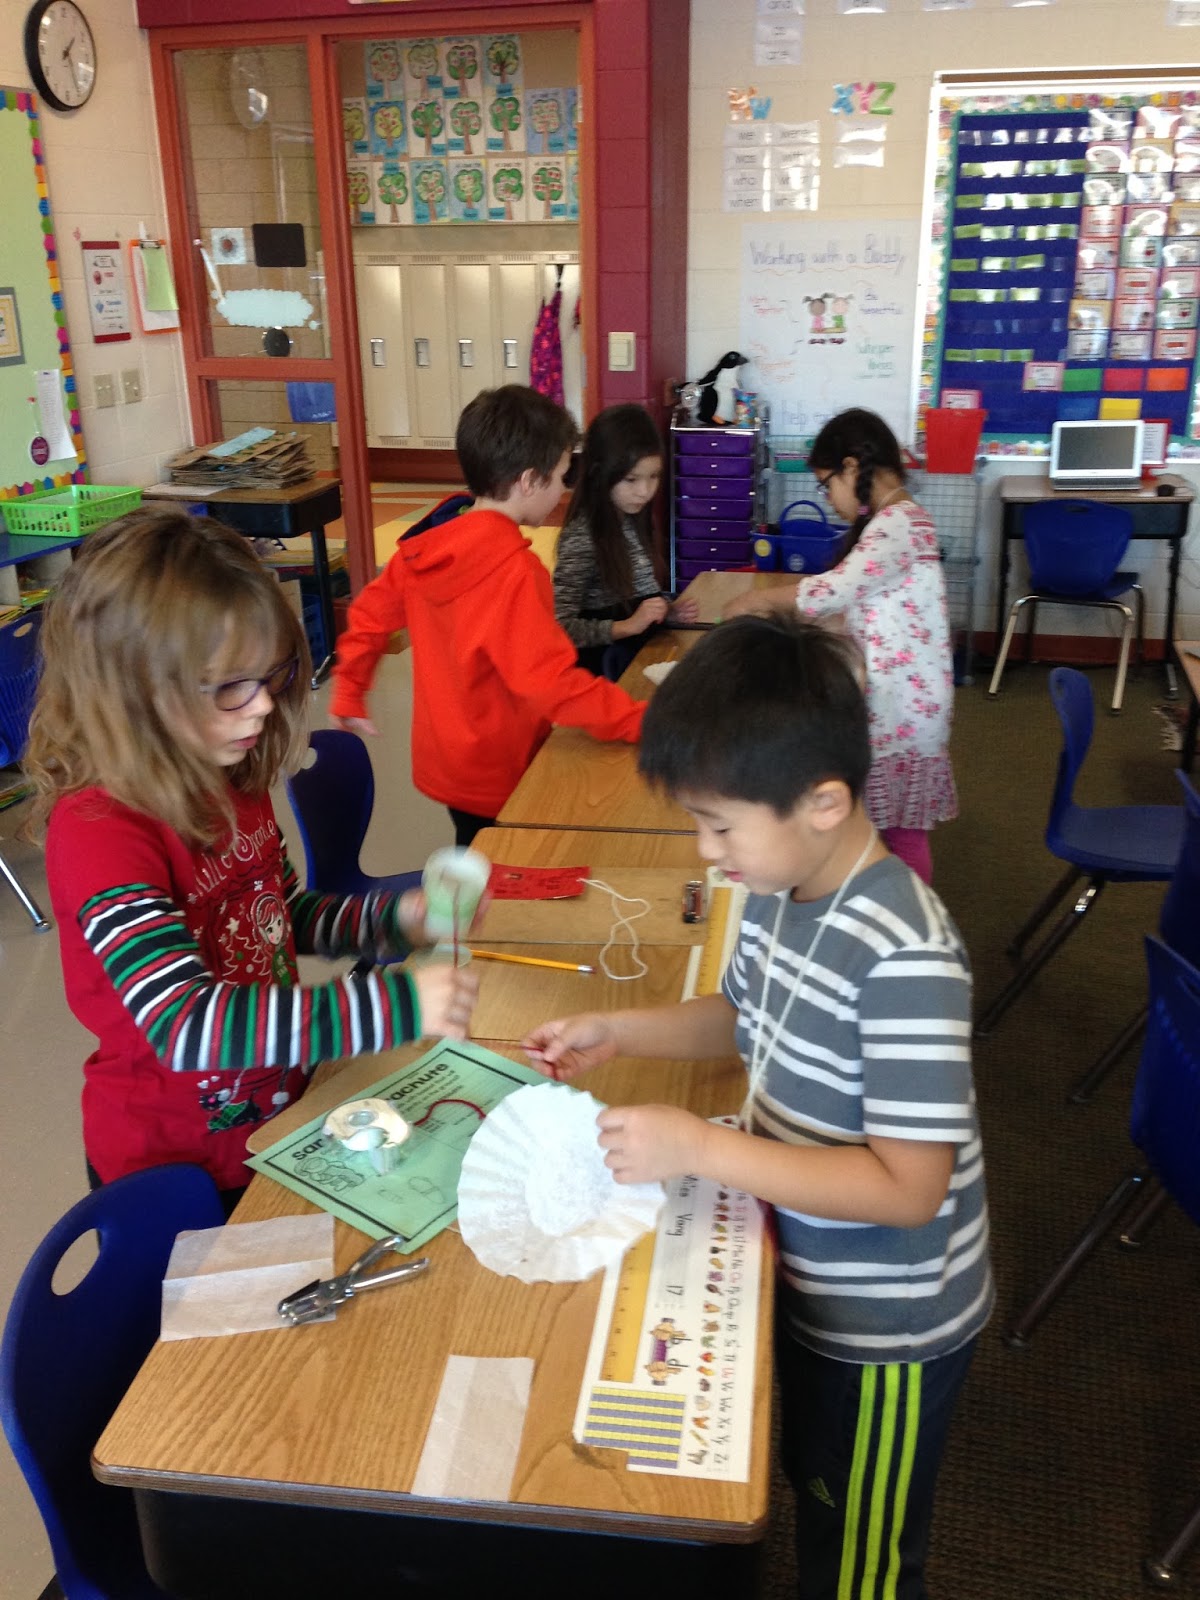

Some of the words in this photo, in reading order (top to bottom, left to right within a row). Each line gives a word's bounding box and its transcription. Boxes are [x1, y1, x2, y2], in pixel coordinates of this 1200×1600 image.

[829, 81, 897, 116] XYZ
[750, 240, 806, 274] Working
[812, 239, 844, 264] with
[846, 252, 858, 264] a
